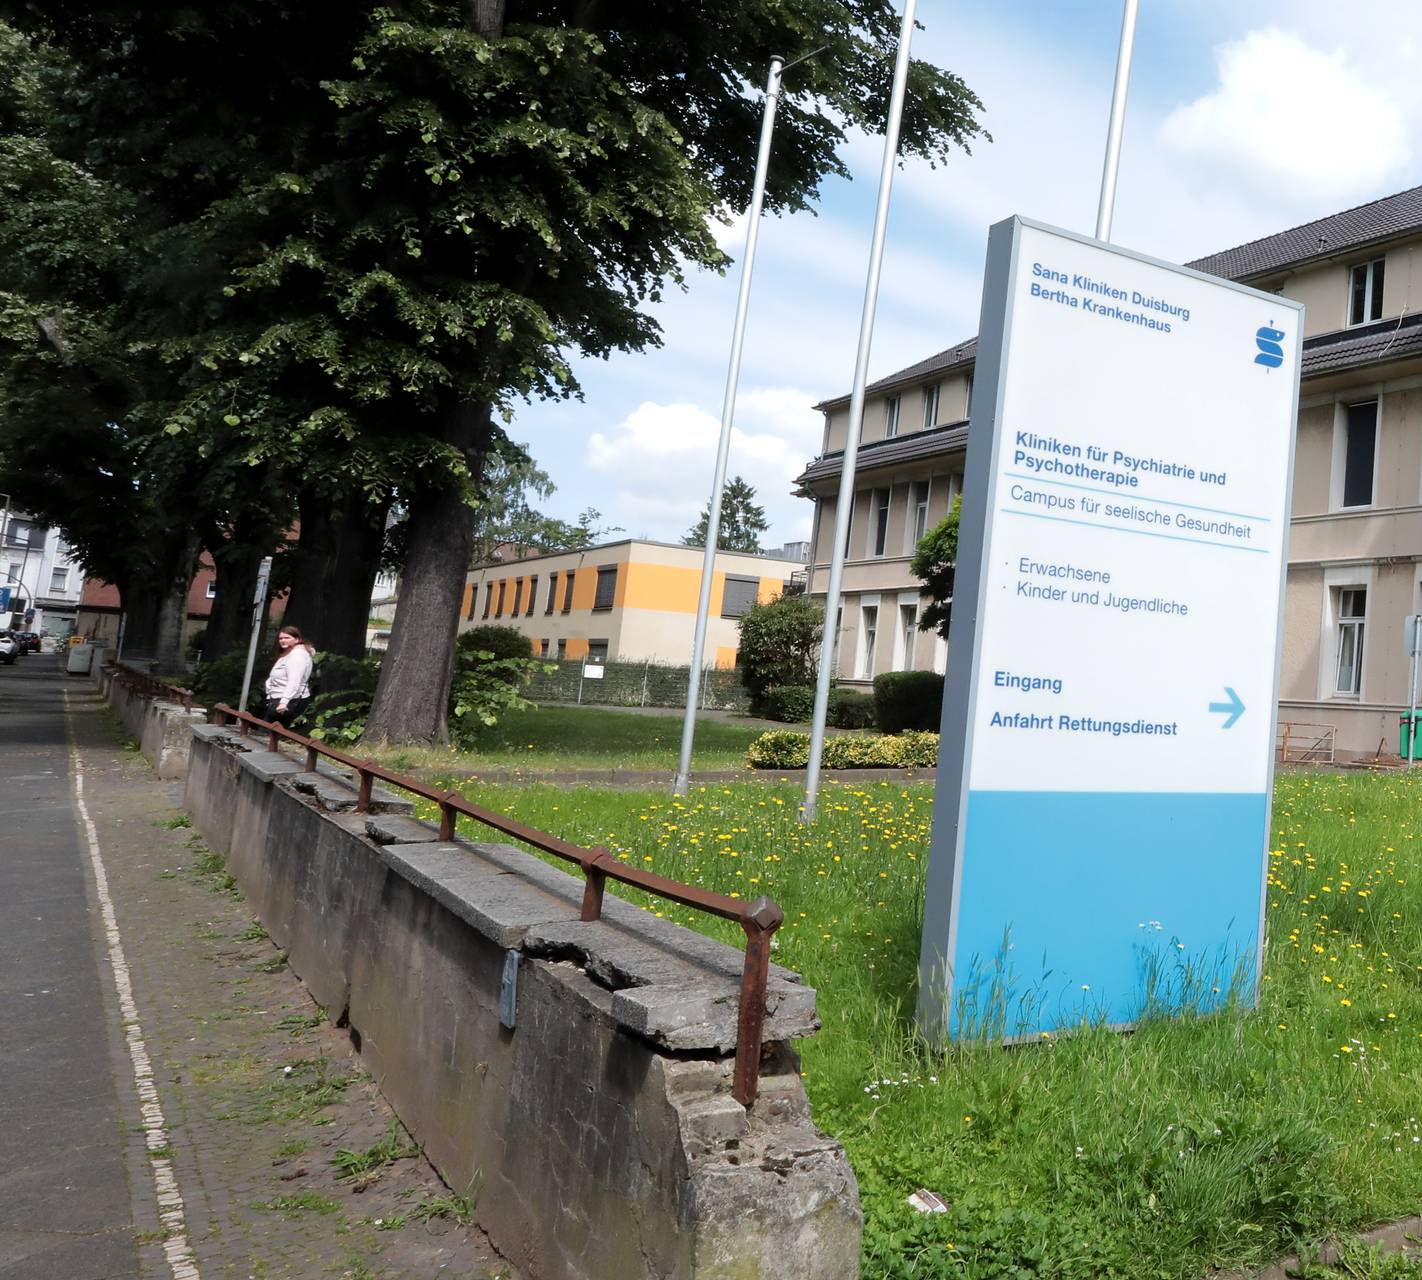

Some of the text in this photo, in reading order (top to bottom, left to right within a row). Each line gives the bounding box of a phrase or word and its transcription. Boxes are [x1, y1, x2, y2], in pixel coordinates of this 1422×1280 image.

[1030, 282, 1172, 334] Bertha Krankenhaus
[1031, 262, 1191, 322] Sana Kliniken Duisburg
[1014, 449, 1139, 488] Psychotherapie
[1015, 430, 1227, 486] Kliniken für Psychiatrie und
[1010, 484, 1251, 539] Campus für seelische Gesundheit
[1019, 557, 1111, 584] Erwachsene
[1016, 580, 1189, 616] Kinder und Jugendliche
[993, 670, 1063, 695] Eingang
[989, 711, 1178, 737] Anfahrt Rettungsdienst
